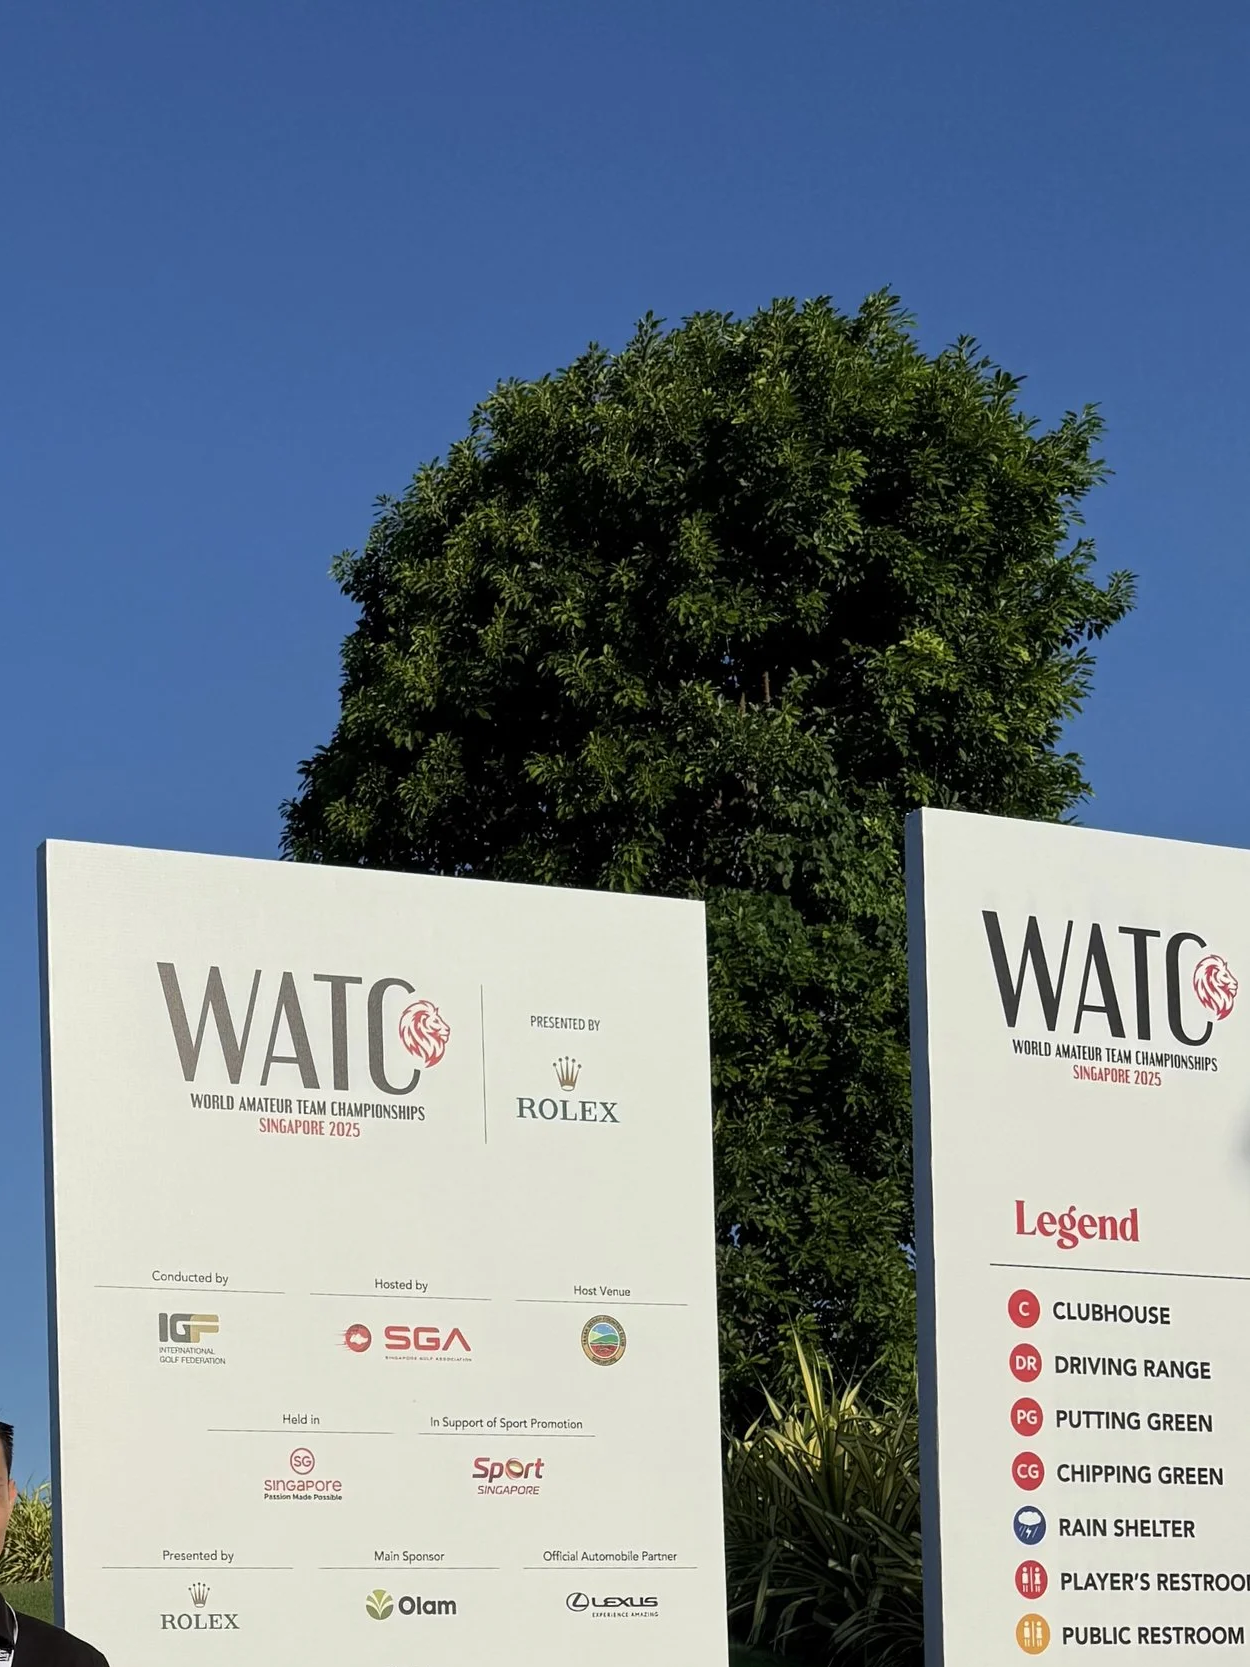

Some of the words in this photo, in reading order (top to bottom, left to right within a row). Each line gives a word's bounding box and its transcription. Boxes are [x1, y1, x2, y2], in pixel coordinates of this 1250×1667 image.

[982, 910, 1213, 1046] WATC
[157, 962, 421, 1096] WATC
[530, 1016, 585, 1030] PRESENTED
[588, 1019, 600, 1031] BY
[1012, 1039, 1051, 1056] WORLD
[1055, 1044, 1102, 1062] AMATEUR
[1105, 1048, 1131, 1064] TEAM
[1136, 1050, 1218, 1072] CHAMPIONSHIPS
[1073, 1064, 1130, 1084] SINGAPORE
[1134, 1070, 1161, 1086] 2025
[190, 1093, 234, 1110] WORLD
[239, 1096, 292, 1114] AMATEUR
[296, 1100, 326, 1115] TEAM
[331, 1101, 425, 1121] CHAMPIONSHIPS
[516, 1098, 620, 1123] ROLEX
[260, 1118, 325, 1135] SINGAPORE
[329, 1121, 360, 1137] 2025
[1015, 1200, 1139, 1250] Legend
[152, 1270, 212, 1283] Conducted
[216, 1272, 228, 1286] by
[375, 1279, 412, 1290] Hosted
[416, 1280, 428, 1293] by
[574, 1286, 597, 1296] Host
[599, 1286, 630, 1296] Venue
[1019, 1302, 1030, 1316] C
[1053, 1302, 1170, 1324] CLUBHOUSE
[158, 1313, 219, 1343] IGF
[159, 1346, 214, 1355] INTERNATIONAL
[181, 1356, 226, 1364] FEDERATION
[1016, 1356, 1037, 1370] DR
[1055, 1356, 1137, 1376] DRIVING
[1144, 1360, 1211, 1379] RANGE
[283, 1414, 307, 1424] Held
[311, 1414, 320, 1424] in
[431, 1417, 440, 1426] In
[442, 1416, 484, 1430] Support
[486, 1417, 497, 1428] of
[500, 1418, 528, 1431] Sport
[531, 1418, 582, 1429] Promotion
[1017, 1410, 1037, 1424] PG
[1056, 1410, 1140, 1430] PUTTING
[1147, 1413, 1212, 1432] GREEN
[294, 1456, 312, 1467] SG
[1017, 1464, 1039, 1479] CG
[1057, 1464, 1151, 1484] CHIPPING
[1158, 1466, 1223, 1485] GREEN
[478, 1485, 540, 1495] SINGAPORE
[1059, 1518, 1106, 1536] RAIN
[1114, 1519, 1195, 1538] SHELTER
[163, 1550, 218, 1560] Presented
[221, 1550, 234, 1564] by
[374, 1551, 400, 1561] Main
[402, 1551, 444, 1564] Sponsor
[543, 1550, 578, 1561] Official
[581, 1550, 639, 1561] Automobile
[642, 1551, 677, 1561] Partner
[1061, 1573, 1150, 1591] PLAYER'S
[1157, 1573, 1250, 1591] RESTROO
[398, 1596, 456, 1615] Olam
[592, 1597, 658, 1607] LEXUS
[160, 1614, 240, 1630] ROLEX
[1063, 1626, 1131, 1645] PUBLIC
[1138, 1626, 1244, 1644] RESTROOM
